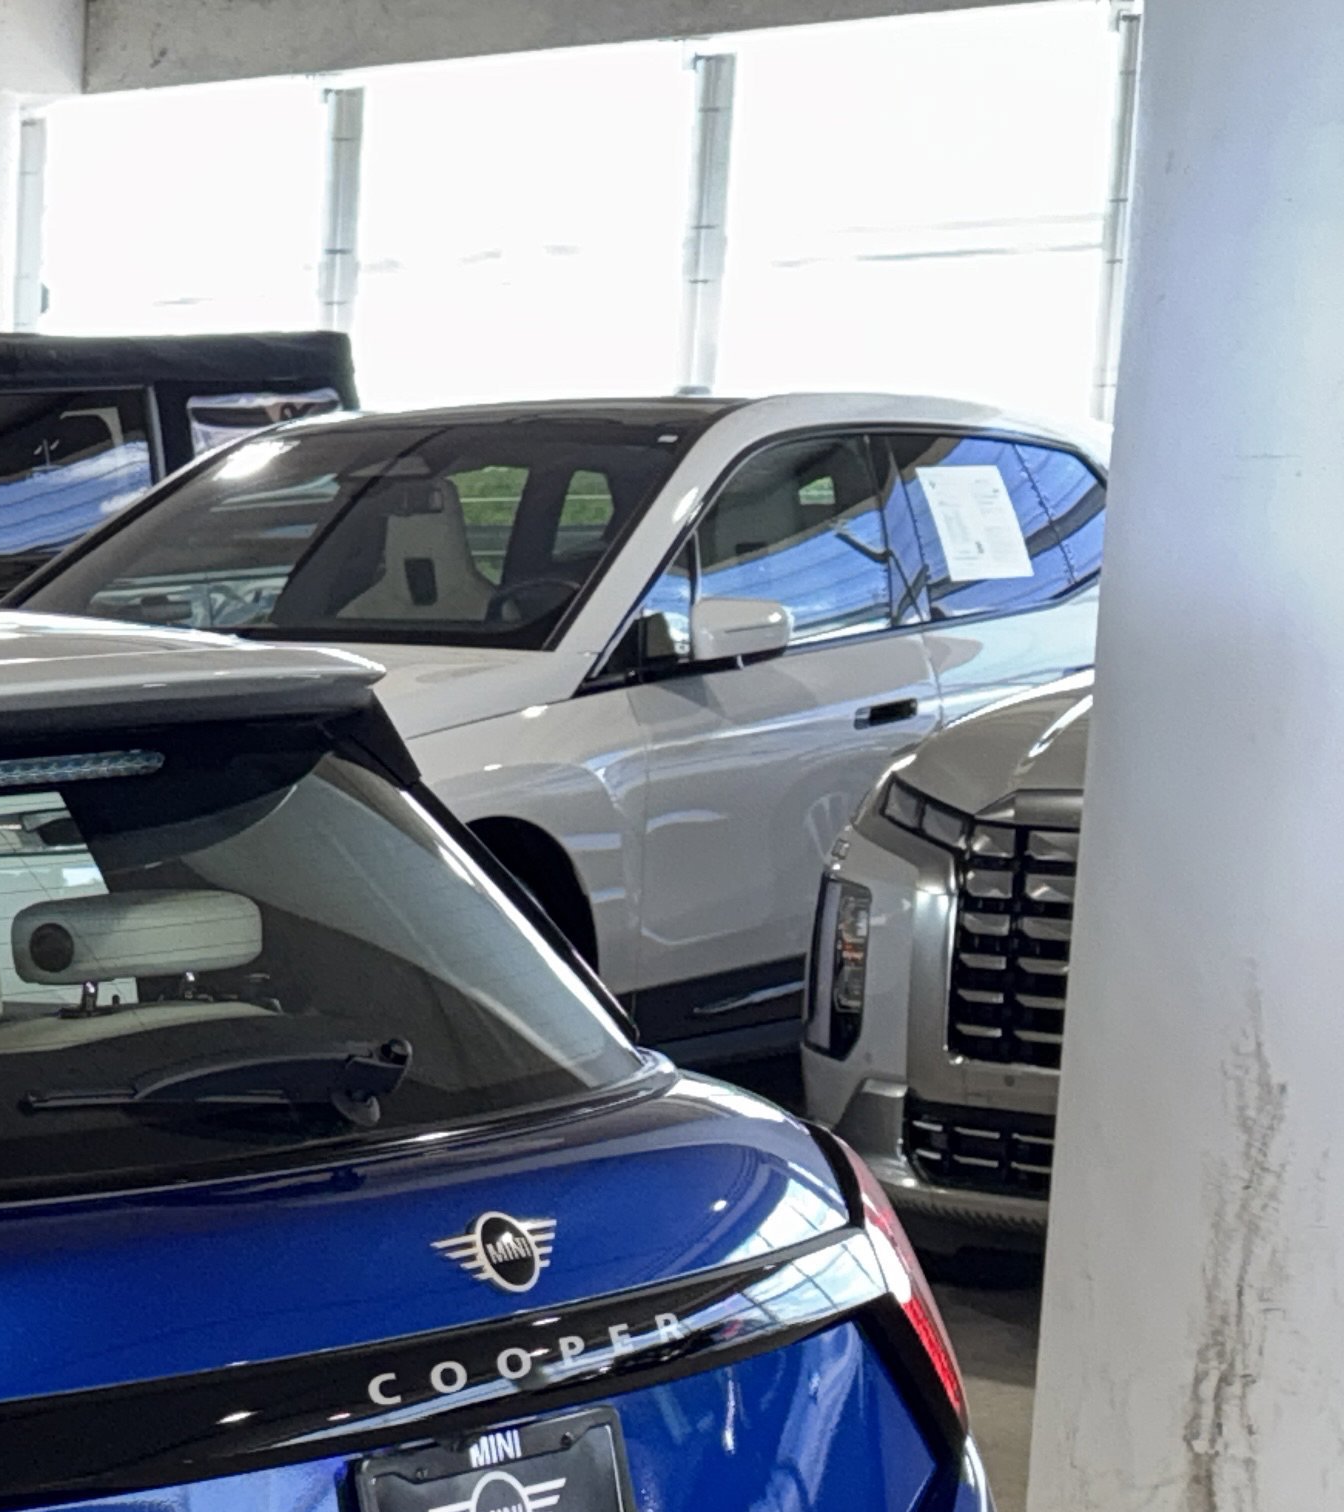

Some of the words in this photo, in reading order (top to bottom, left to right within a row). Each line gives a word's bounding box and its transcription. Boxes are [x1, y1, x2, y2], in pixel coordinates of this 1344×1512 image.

[486, 1234, 533, 1265] MINI
[367, 1312, 686, 1405] COOPER
[469, 1429, 522, 1468] MINI
